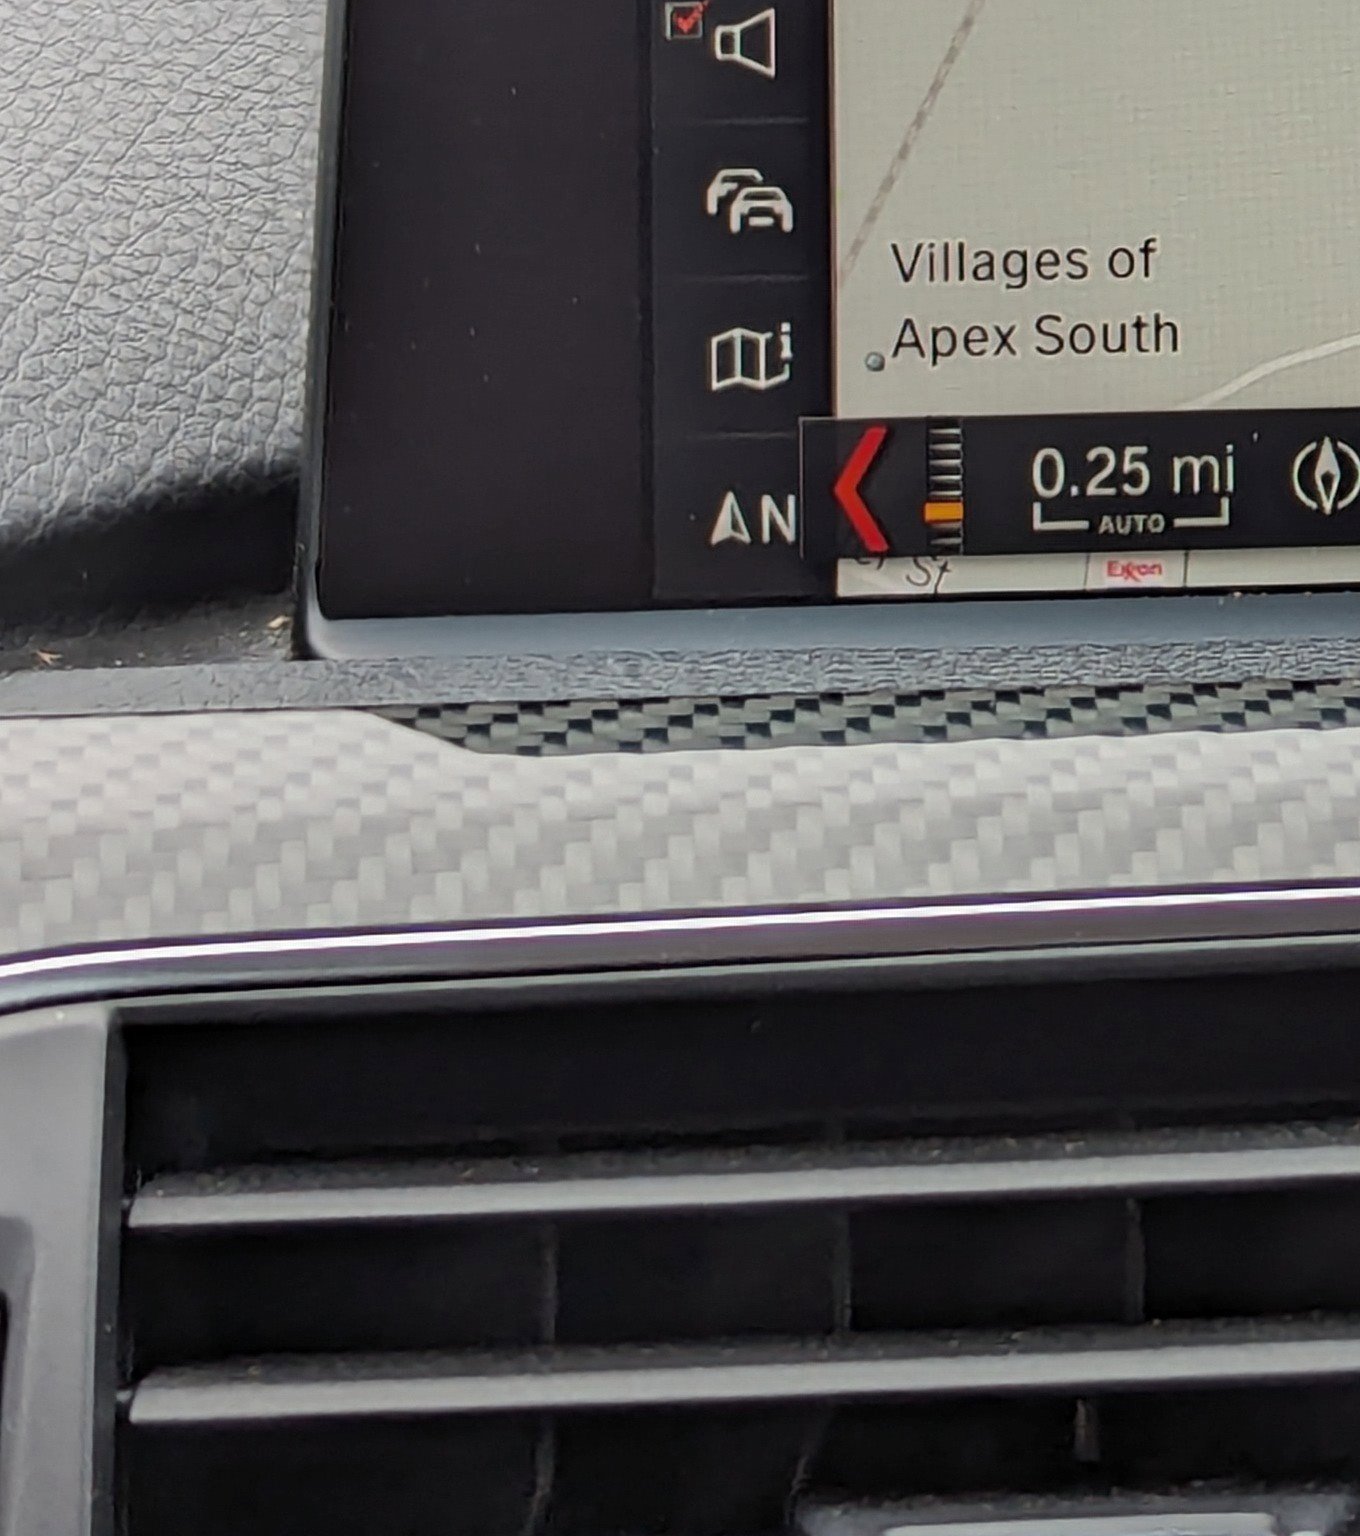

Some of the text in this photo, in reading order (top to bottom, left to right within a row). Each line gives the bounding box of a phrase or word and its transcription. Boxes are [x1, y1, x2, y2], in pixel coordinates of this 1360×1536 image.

[892, 237, 1158, 291] Villages of
[892, 313, 1179, 367] Apex South
[1032, 445, 1234, 499] 0.25 mi
[1098, 512, 1165, 534] AUTO
[1106, 560, 1163, 582] Exxon
